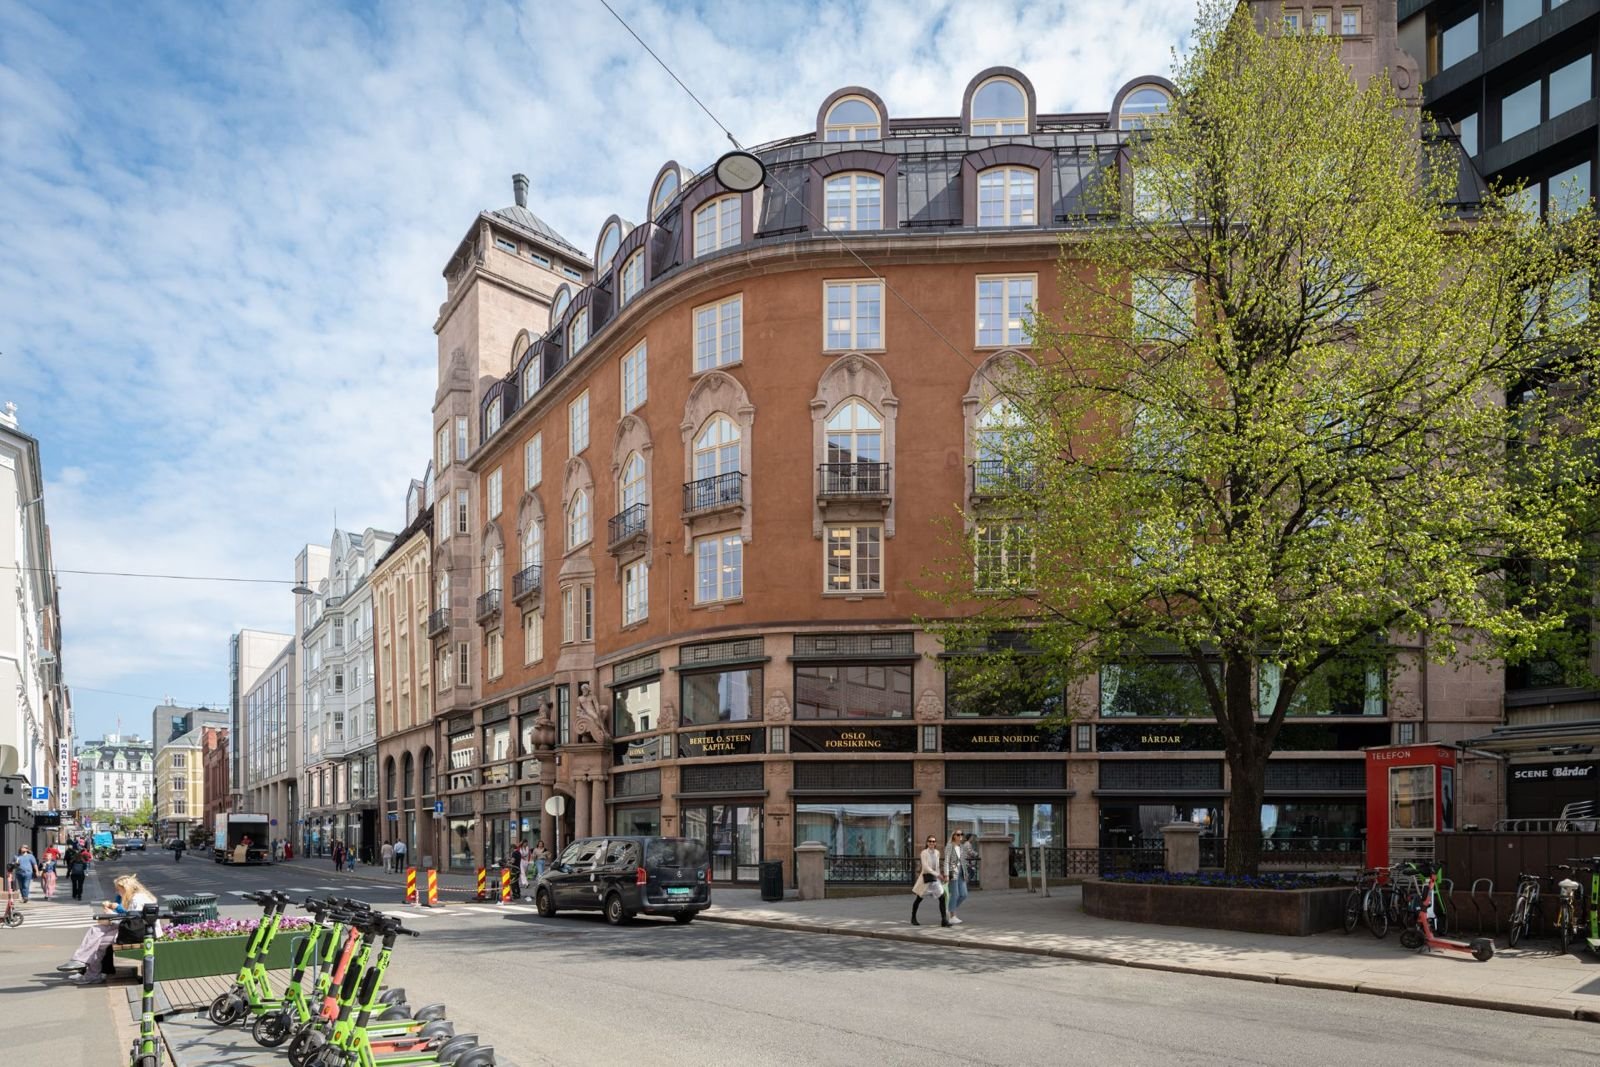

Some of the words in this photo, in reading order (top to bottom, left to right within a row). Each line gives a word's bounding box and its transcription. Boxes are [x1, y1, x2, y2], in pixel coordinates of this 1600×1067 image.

[690, 736, 714, 745] BERTEL
[726, 734, 751, 742] STEEN
[841, 732, 866, 740] OSLO
[971, 735, 1000, 743] ABLER
[1002, 735, 1040, 743] NORDIC
[1141, 733, 1181, 743] BÅRDAR
[702, 743, 736, 752] KAPITAL
[825, 740, 882, 748] FORSIKRING
[1371, 751, 1411, 760] TELEFON
[1514, 769, 1549, 779] SCENE
[36, 789, 45, 798] P
